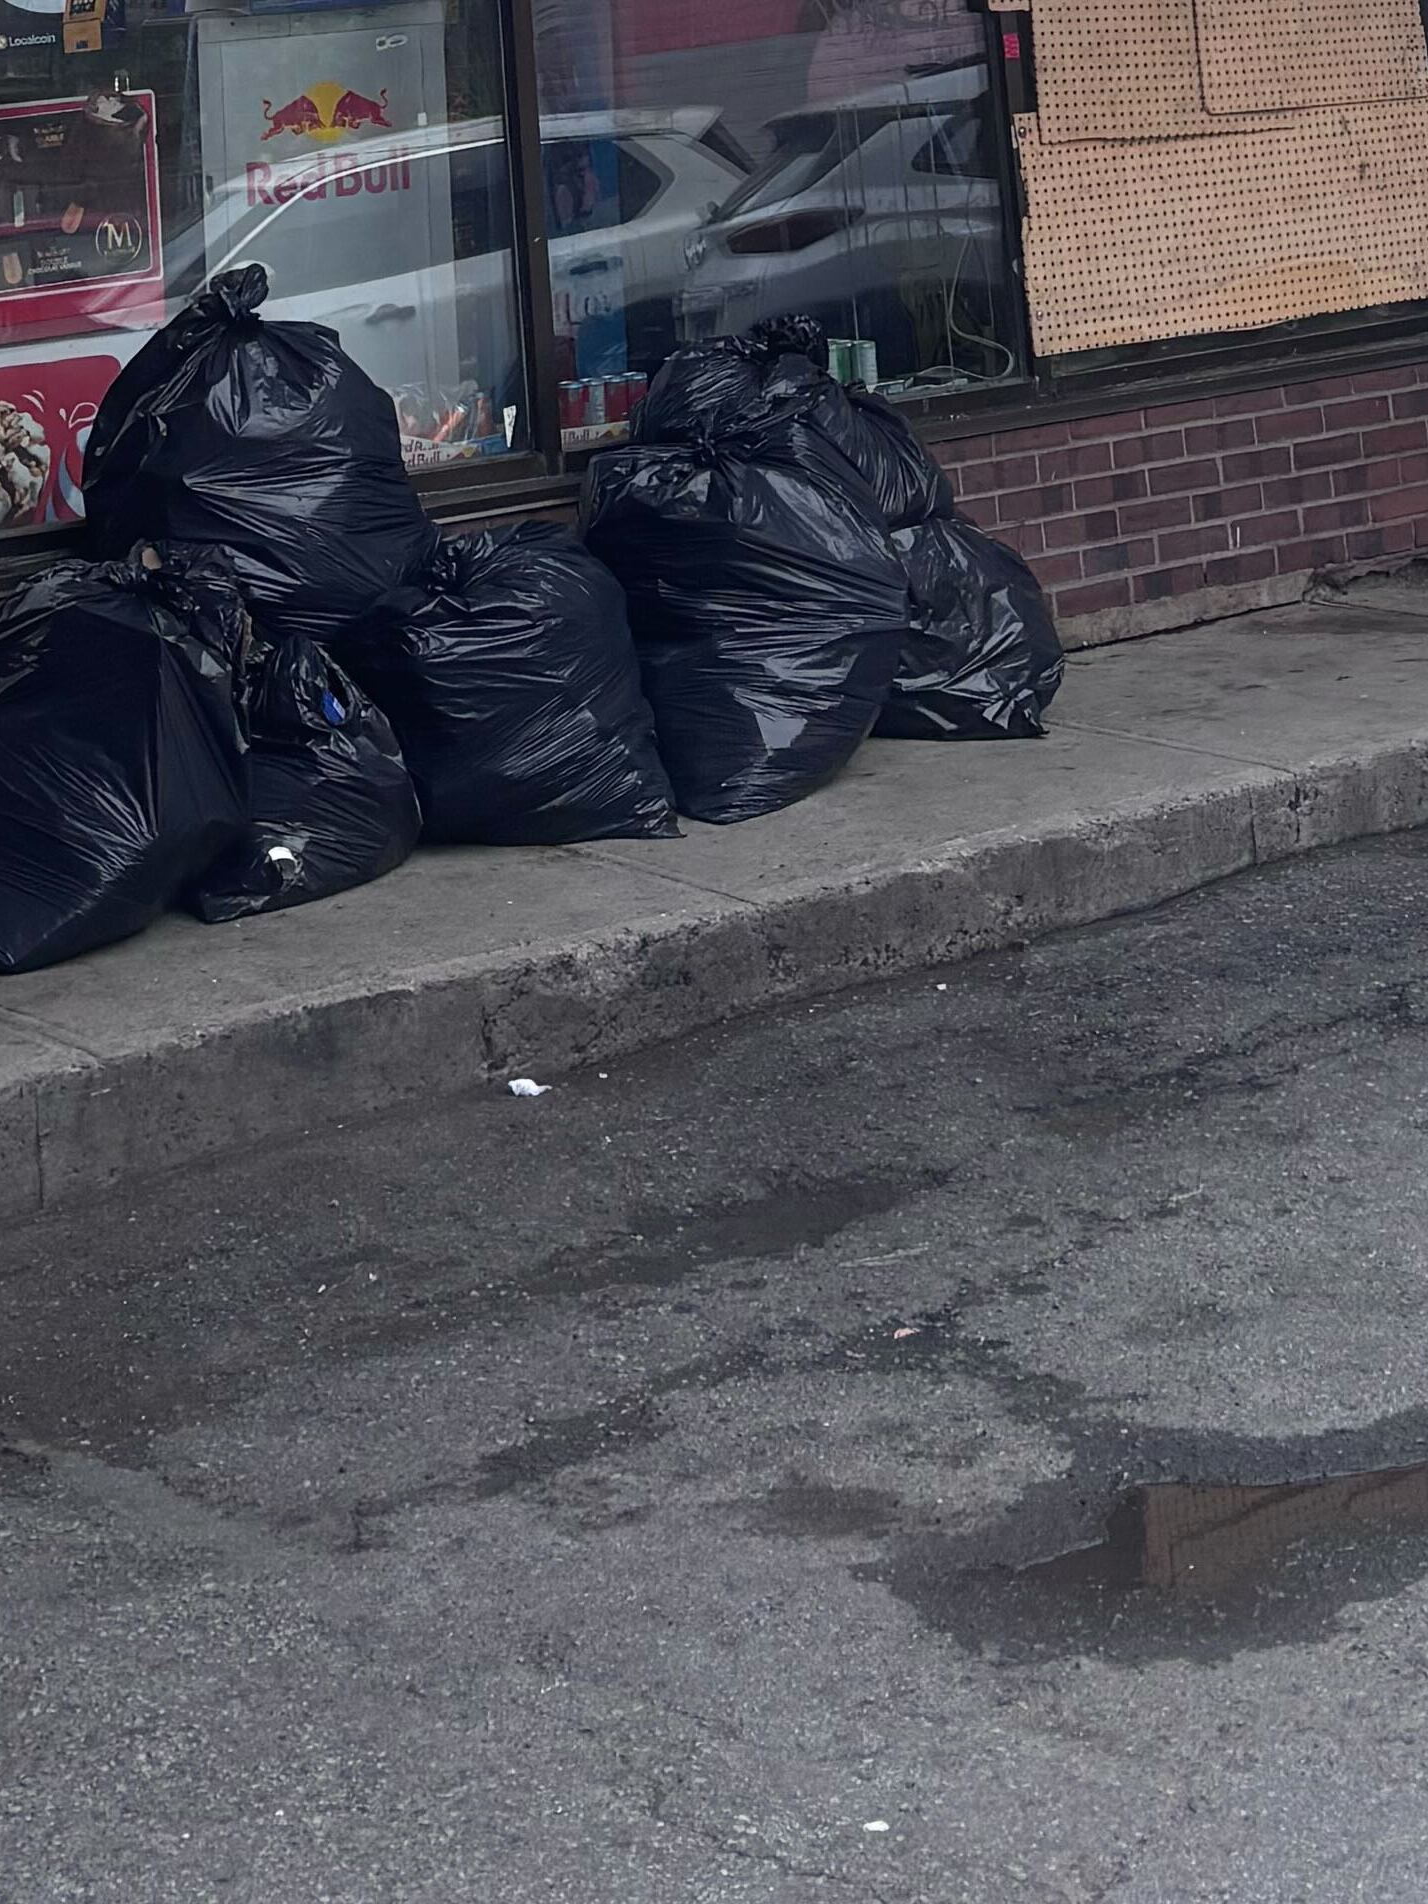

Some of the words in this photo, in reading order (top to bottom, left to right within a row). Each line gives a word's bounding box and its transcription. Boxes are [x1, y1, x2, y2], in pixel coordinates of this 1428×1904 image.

[8, 32, 56, 48] Localcoin
[245, 151, 332, 208] Red
[333, 143, 411, 198] Bull
